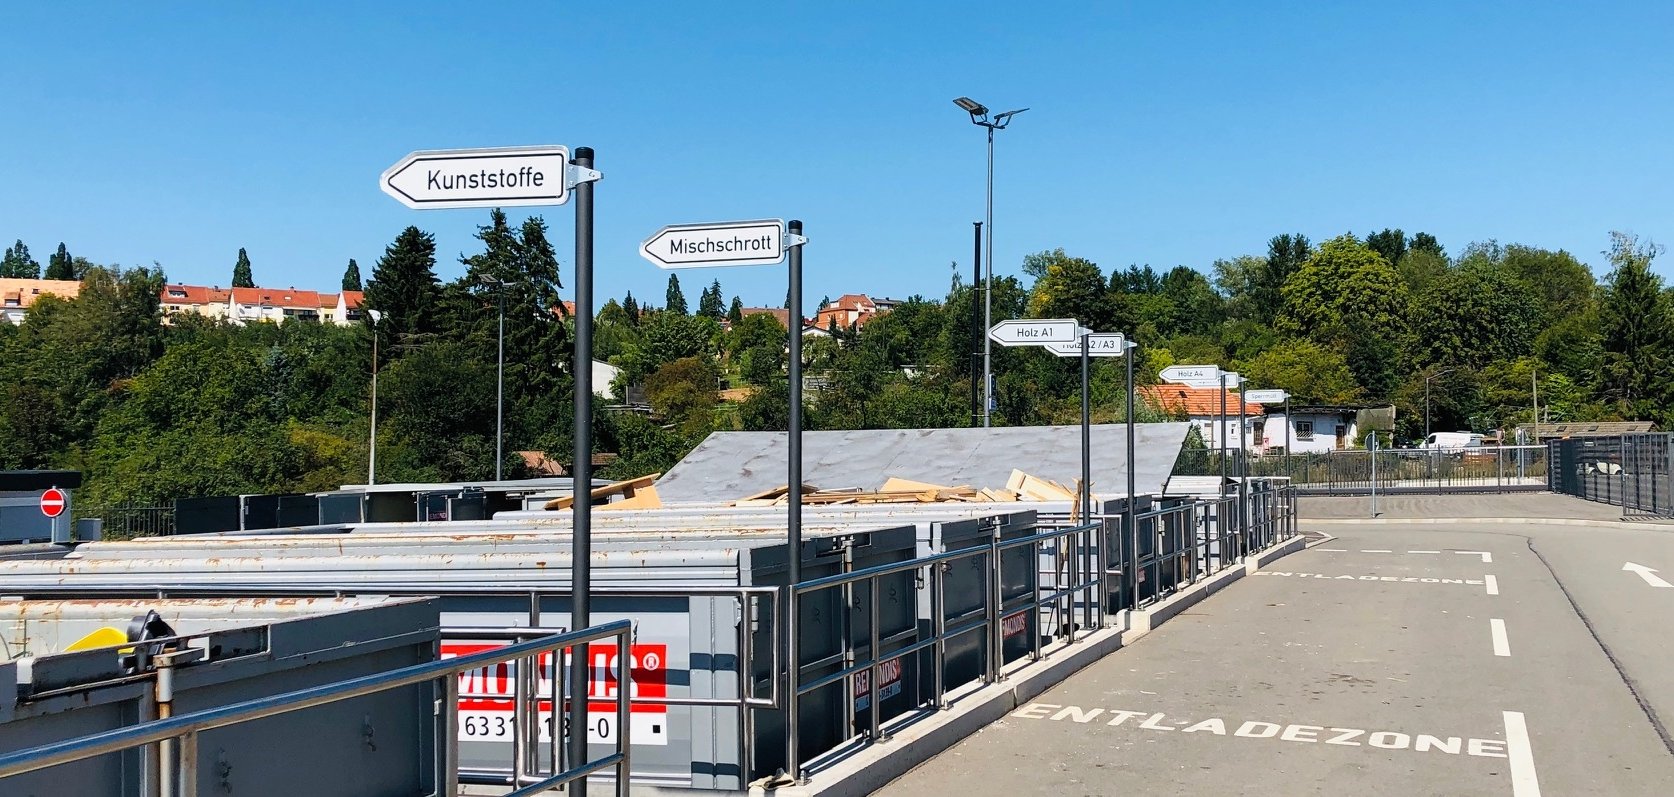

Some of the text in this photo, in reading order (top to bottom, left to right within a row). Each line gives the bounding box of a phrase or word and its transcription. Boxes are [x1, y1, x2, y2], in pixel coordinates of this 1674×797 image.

[427, 166, 545, 191] Kunststoffe
[669, 236, 772, 255] Mischschrott
[1017, 328, 1053, 337] Holz A1
[1103, 341, 1115, 349] A3
[1251, 571, 1485, 585] ENTLADEZONE
[1012, 703, 1508, 758] ENTLADEZONE
